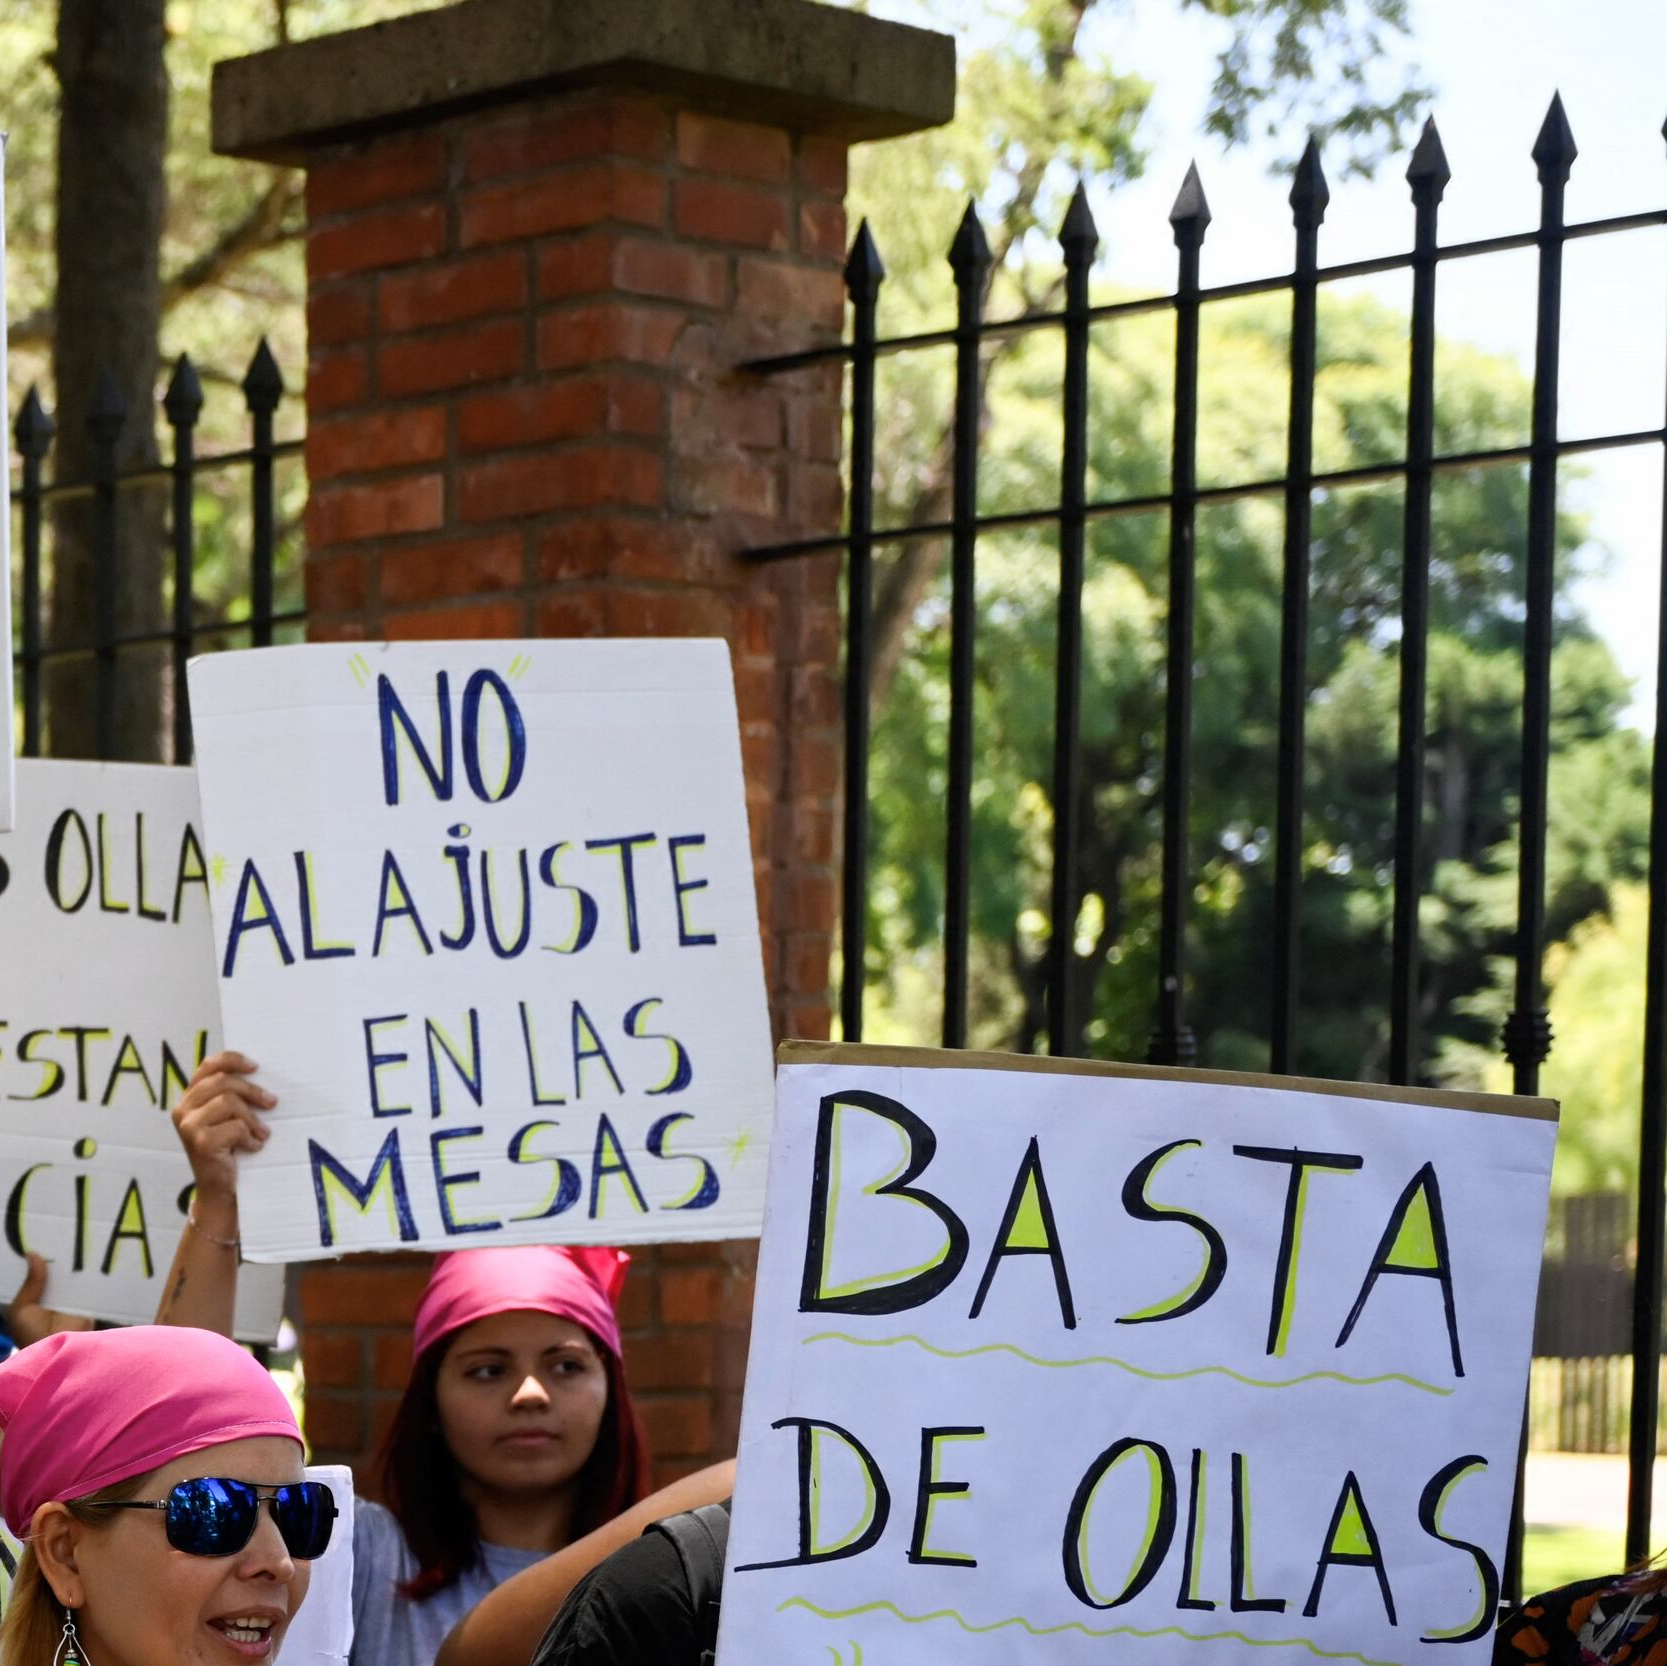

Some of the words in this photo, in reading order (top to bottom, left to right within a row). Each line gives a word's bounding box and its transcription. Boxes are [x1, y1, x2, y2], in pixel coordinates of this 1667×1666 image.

[222, 850, 356, 979] AL
[363, 1008, 485, 1119] EN
[520, 998, 693, 1106] LAS
[308, 1112, 721, 1248] MESAS
[797, 1090, 1466, 1378] BASTA
[734, 1418, 987, 1573] DE
[1063, 1437, 1500, 1644] OLLAS
